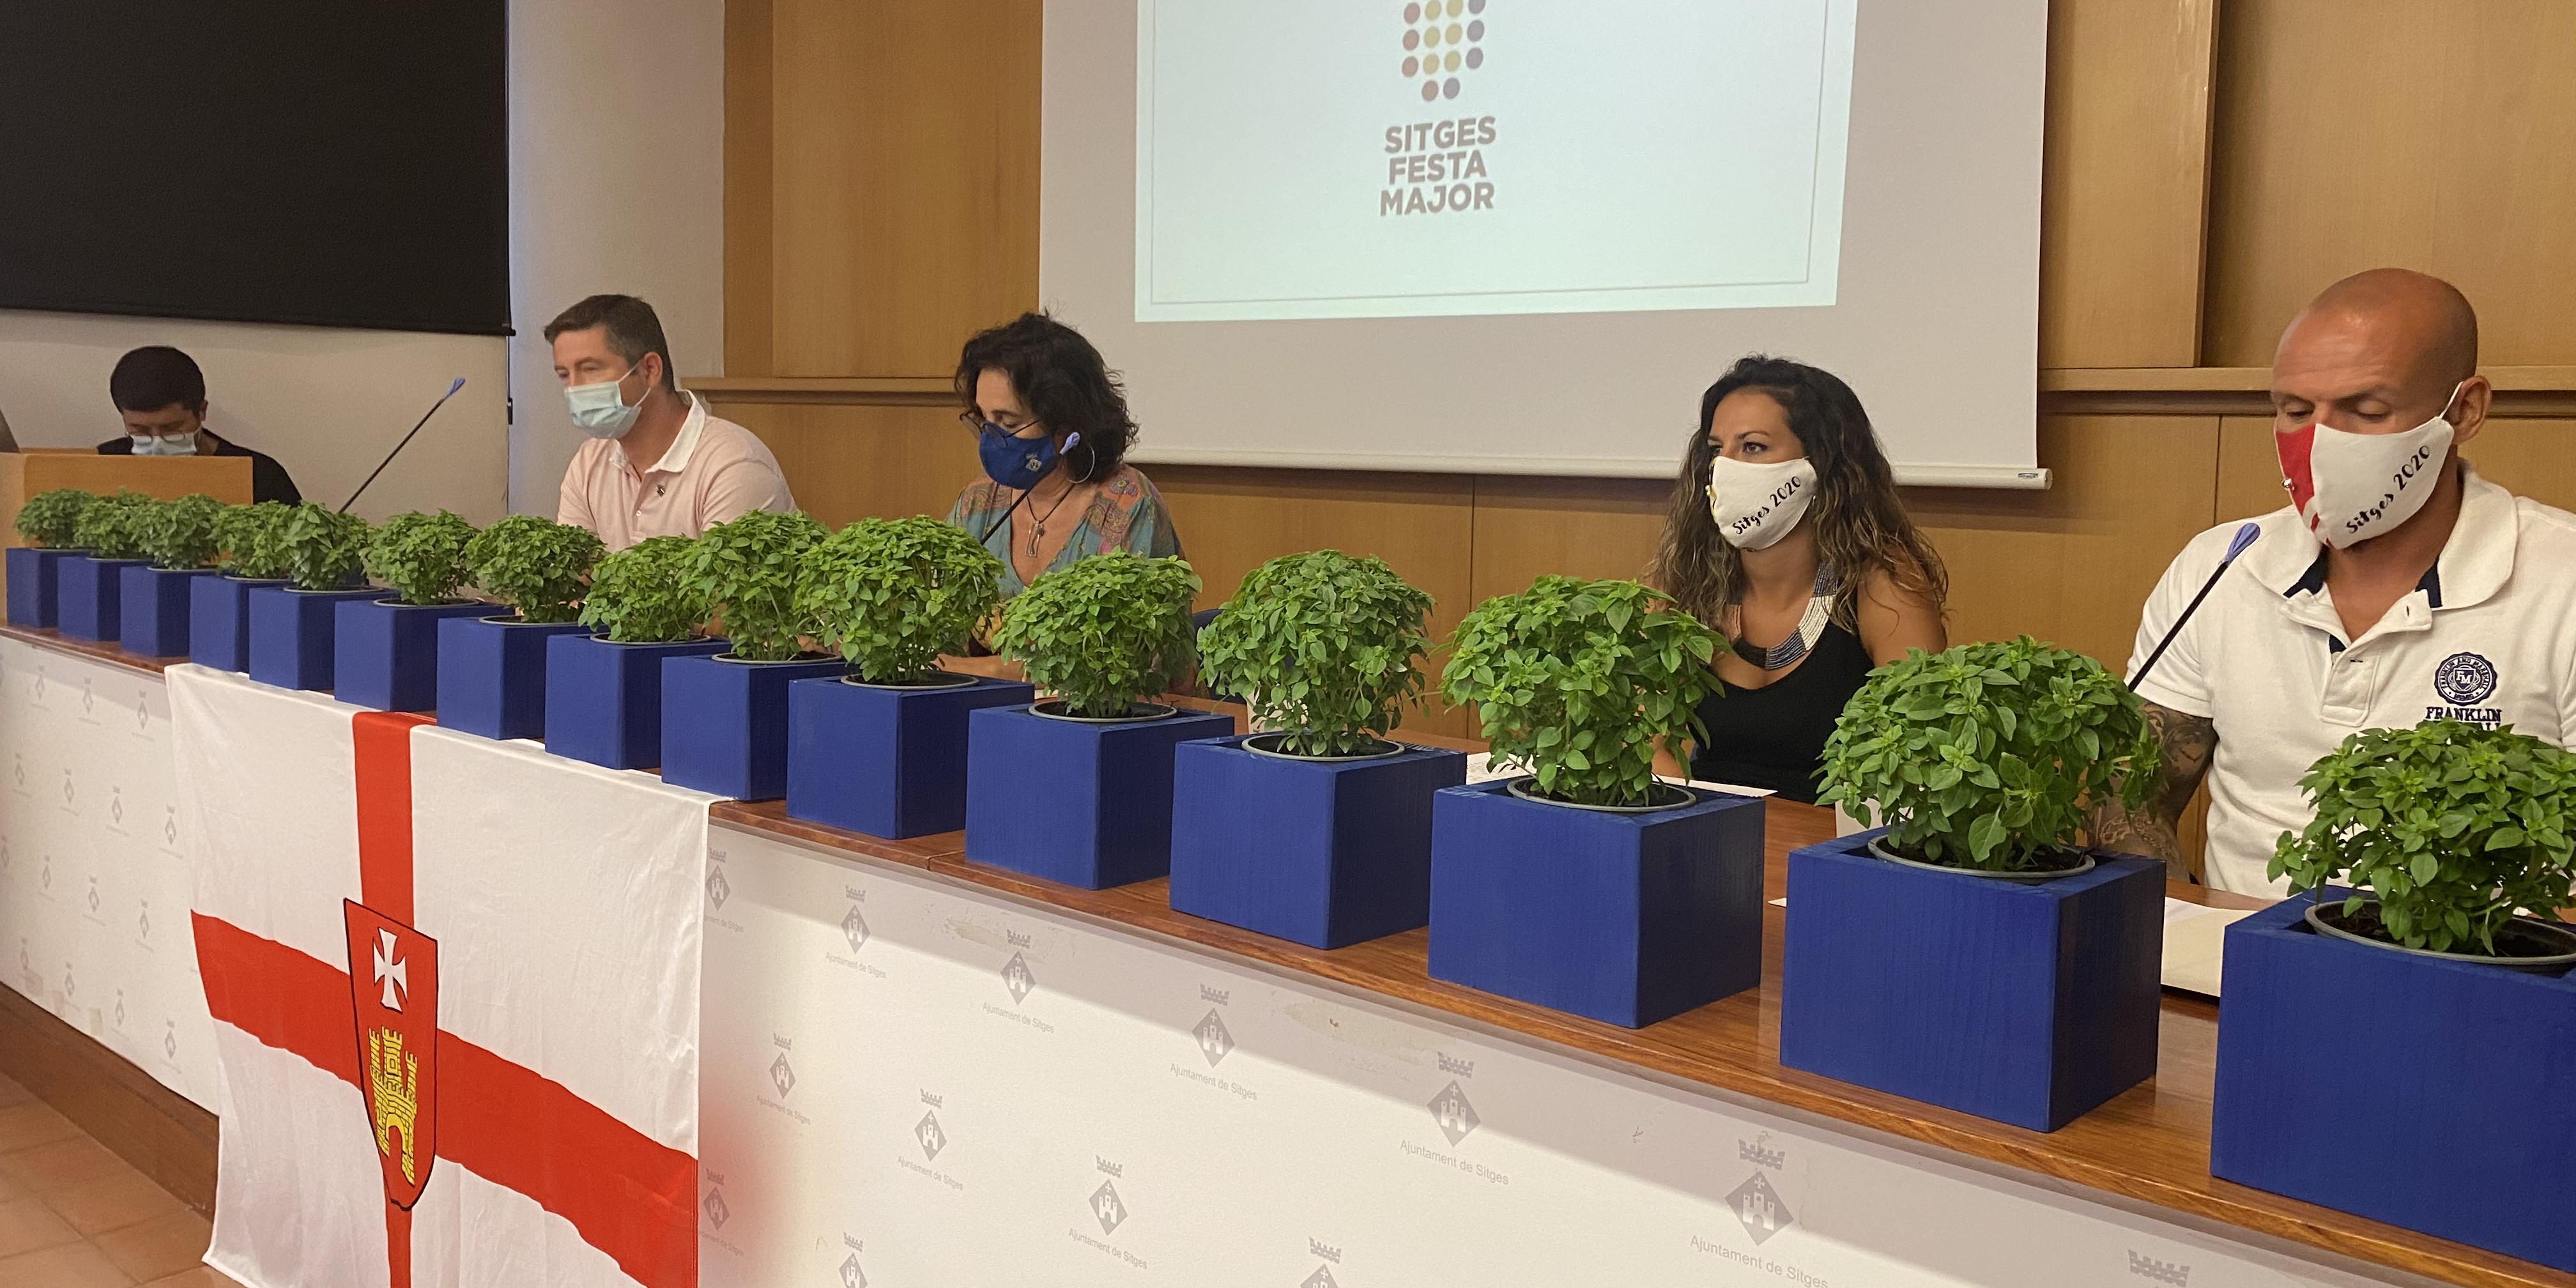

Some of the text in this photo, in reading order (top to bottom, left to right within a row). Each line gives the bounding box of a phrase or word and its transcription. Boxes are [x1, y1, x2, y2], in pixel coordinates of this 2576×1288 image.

[1384, 116, 1496, 153] SITGES
[1389, 150, 1487, 185] FESTA
[1380, 182, 1495, 216] MAJOR
[1732, 476, 1801, 534] Sitges 2020
[2346, 445, 2430, 534] Sitges 2020
[2425, 707, 2503, 721] FRANKLIN
[983, 1002, 1054, 1033] Ajuntament de Sitges
[1170, 1063, 1257, 1100] Ajuntament de Sitges
[1400, 1140, 1509, 1185] Ajuntament de Sitges
[1068, 1228, 1147, 1269] Ajuntament de Sitges
[1690, 1235, 1828, 1288] Ajuntament de Sitges
